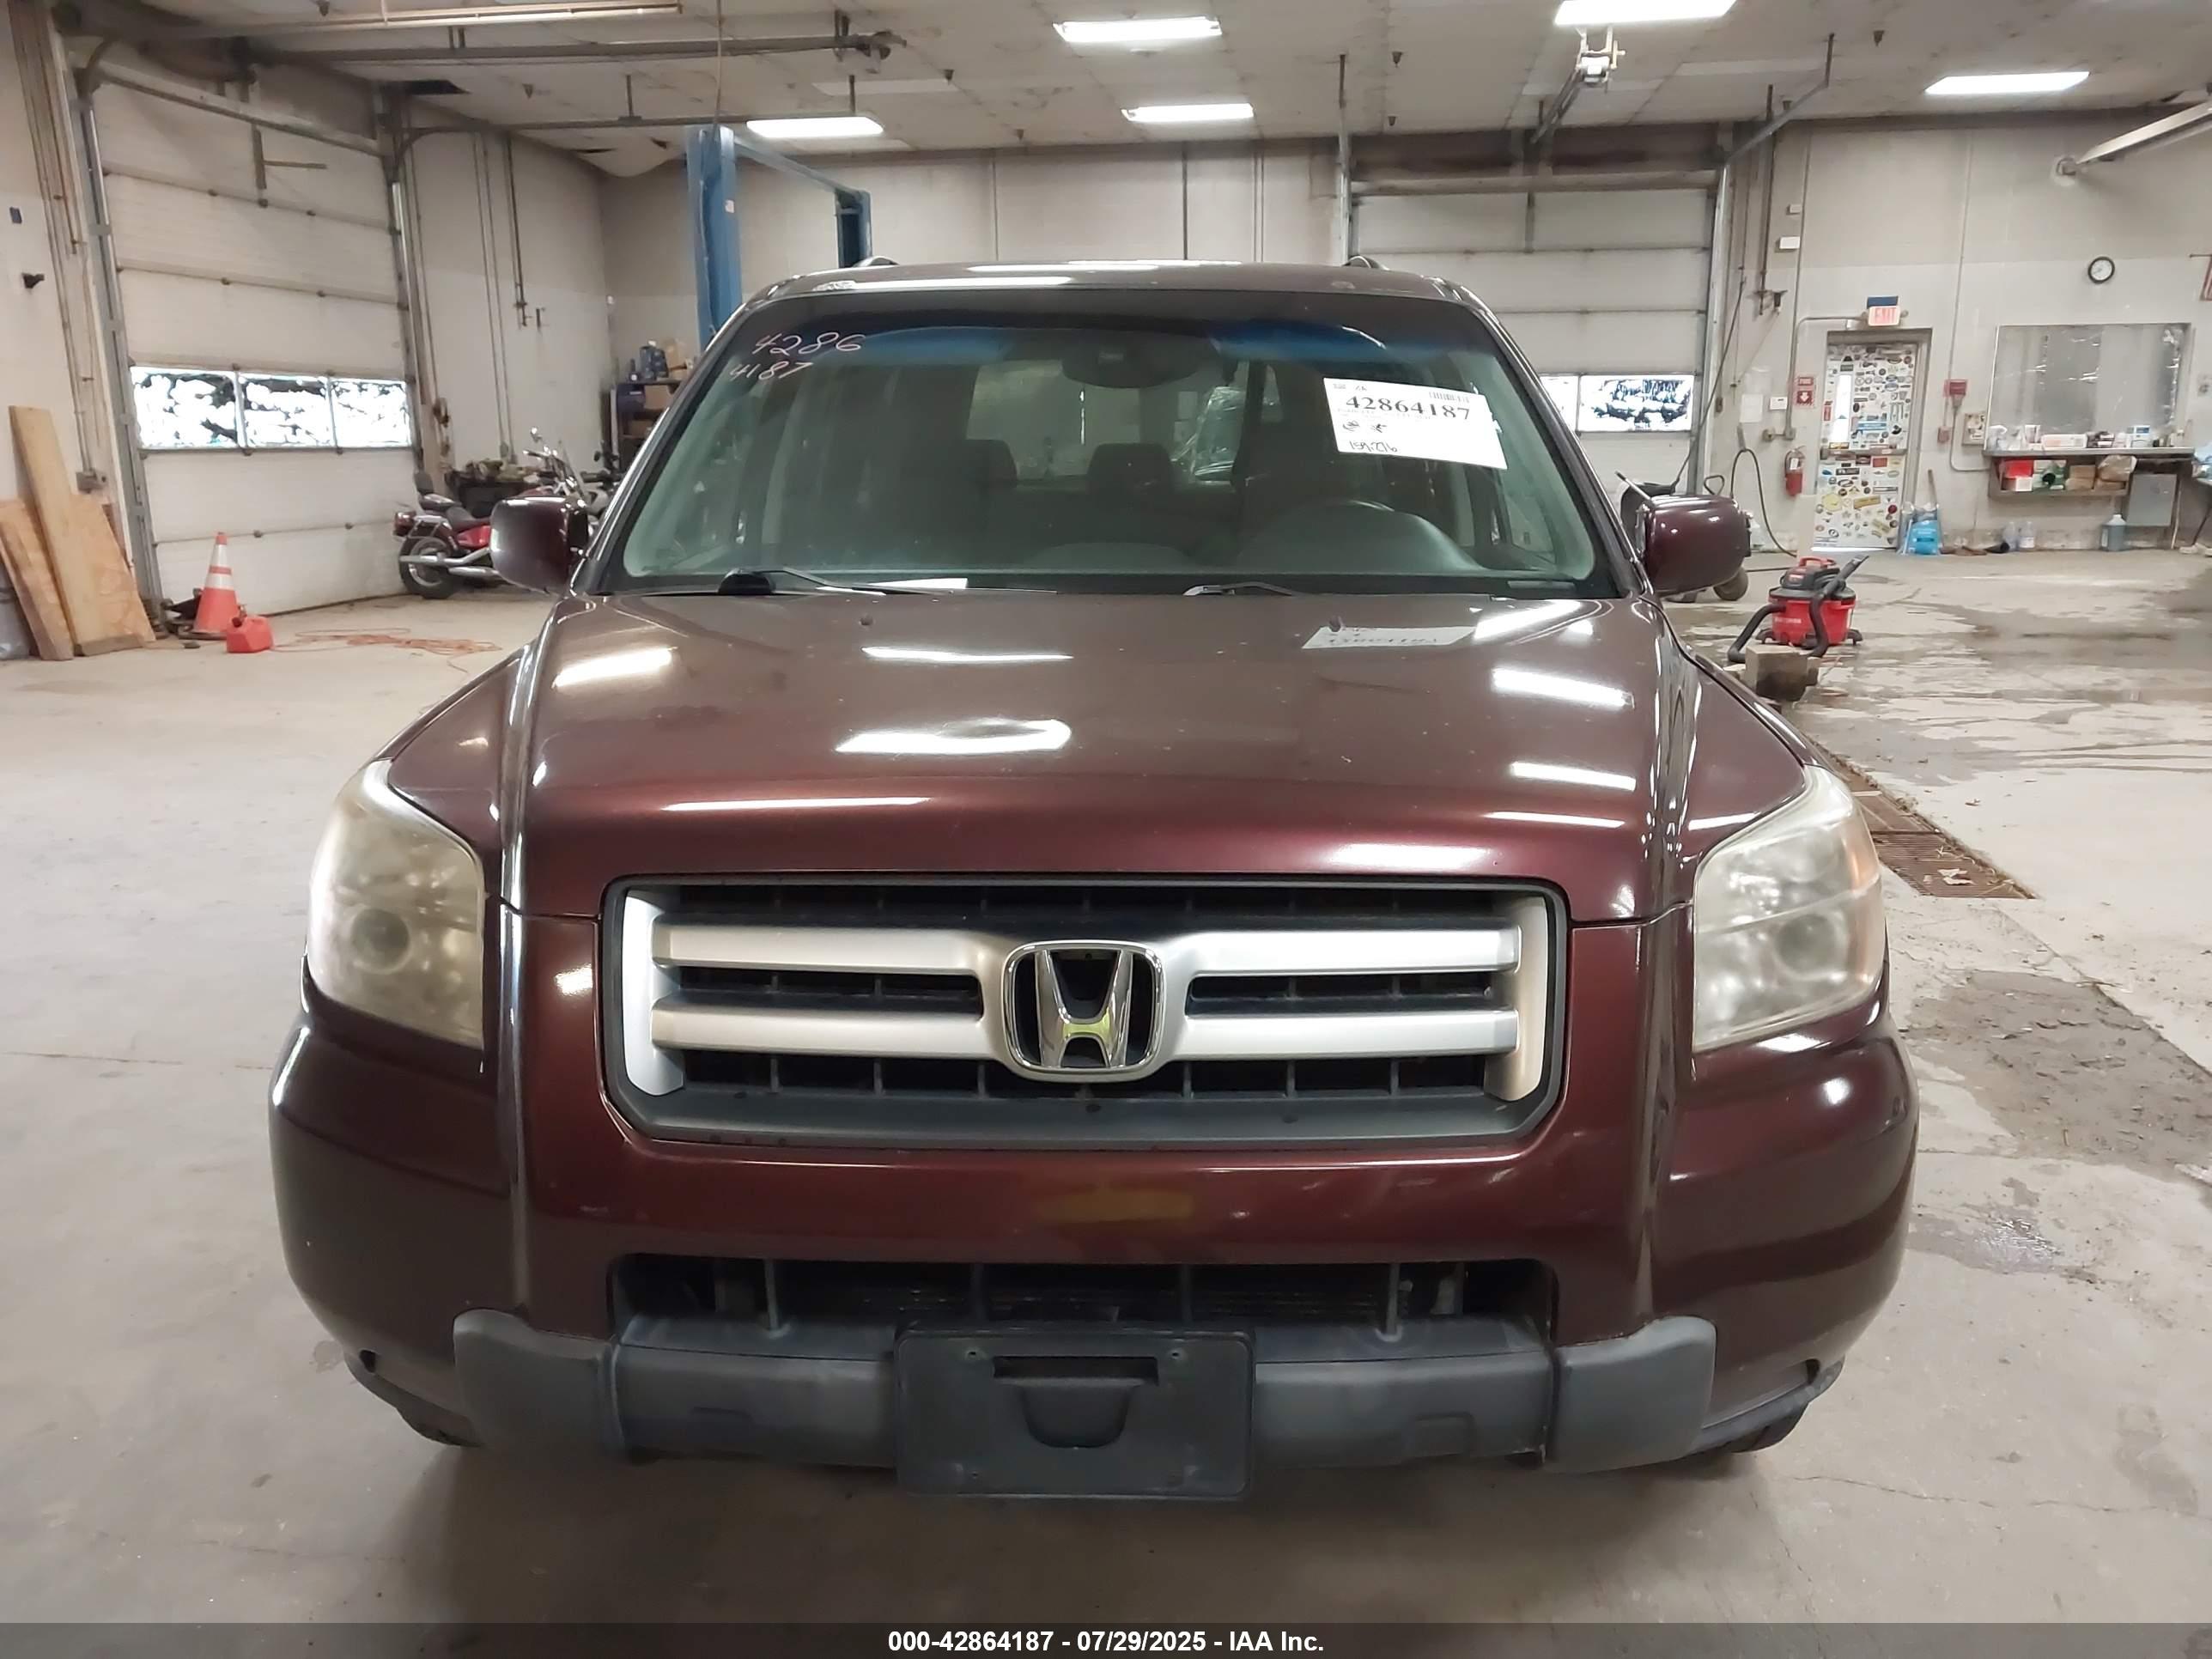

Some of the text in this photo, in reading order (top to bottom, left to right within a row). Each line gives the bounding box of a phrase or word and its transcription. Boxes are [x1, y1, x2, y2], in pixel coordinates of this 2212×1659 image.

[752, 331, 866, 356] 4286
[730, 361, 813, 380] 4187
[1346, 395, 1470, 420] 42864187
